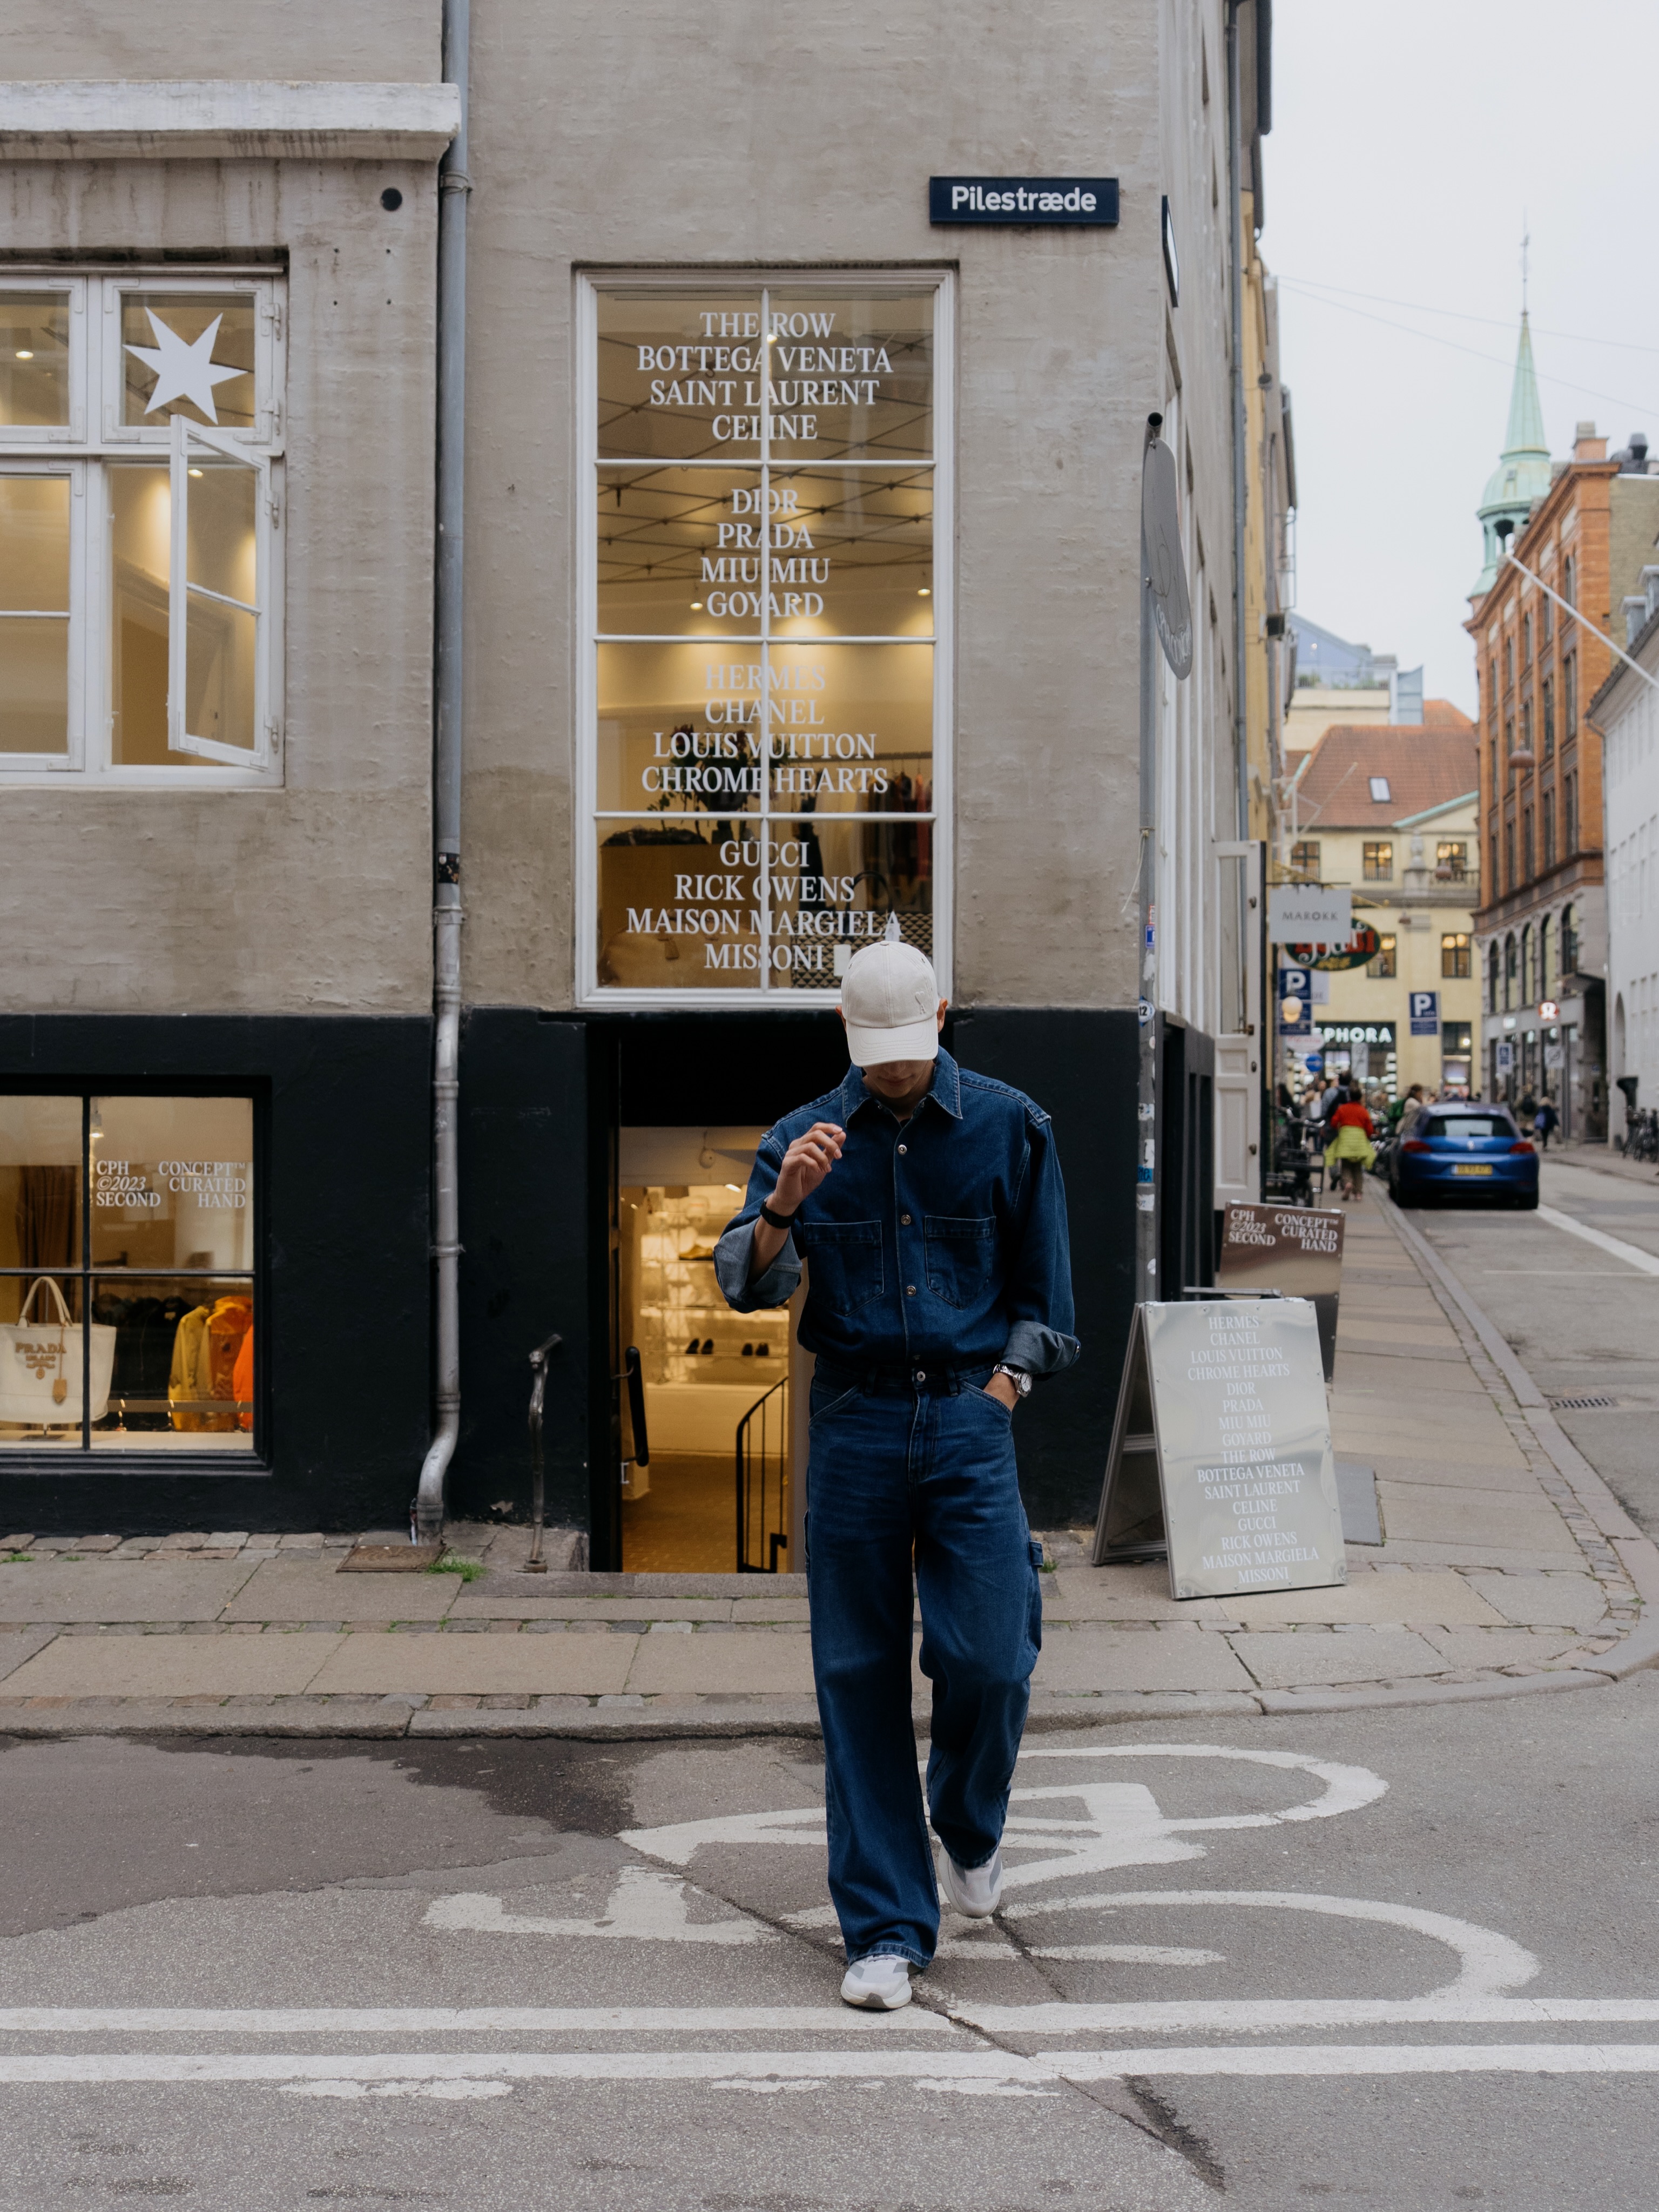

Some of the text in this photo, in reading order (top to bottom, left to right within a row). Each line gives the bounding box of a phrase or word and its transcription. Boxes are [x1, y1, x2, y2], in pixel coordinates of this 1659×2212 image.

[952, 186, 1097, 211] Pilestræde
[700, 313, 836, 338] THE ROW
[777, 347, 893, 373] VENETA
[650, 380, 880, 406] SAINT LAURENT
[712, 415, 818, 441] CELINE
[732, 489, 799, 514] DIOR
[700, 557, 830, 584] MIU MIU
[706, 591, 824, 617] GOYARD
[705, 699, 824, 725] CHANEL
[654, 732, 876, 759] LOUIS VUITTON
[642, 767, 888, 794] CHROME HEARTS
[719, 841, 810, 867] GUCCI
[674, 875, 855, 902] RICK OWENS
[626, 908, 902, 936] MAISON MARGIELA
[1283, 912, 1338, 920] MAROKK
[1414, 994, 1432, 1016] P
[1312, 1027, 1392, 1043] PHORA
[96, 1160, 130, 1176] CPH
[96, 1176, 246, 1192] ©2023 CURATED
[96, 1192, 246, 1209] SECOND HAND
[1231, 1209, 1255, 1222] CPH
[1229, 1231, 1337, 1252] SECOND HAND
[1282, 1225, 1338, 1242] CURATED
[1209, 1312, 1260, 1330] HERMÈS
[15, 1343, 66, 1353] PRADA
[1210, 1332, 1260, 1346] CHANEL
[1191, 1347, 1283, 1364] LOUIS VUITTON
[1188, 1363, 1290, 1381] CHROME HEARTS
[1226, 1382, 1256, 1395] DIOR
[1223, 1399, 1264, 1412] PRADA
[1218, 1414, 1271, 1430] MIU MIU
[1223, 1432, 1271, 1447] GOYARD
[1221, 1447, 1276, 1464] THE ROW
[1197, 1463, 1305, 1482] BOTTEGA VENETA
[1204, 1480, 1300, 1500] SAINT LAURENT
[1232, 1499, 1278, 1514] CELINE
[1238, 1516, 1277, 1532] GUCCI
[1222, 1532, 1297, 1550] RICK OWENS
[1203, 1547, 1319, 1569] MAISON MARGIELA
[1238, 1567, 1289, 1583] MISSONI
